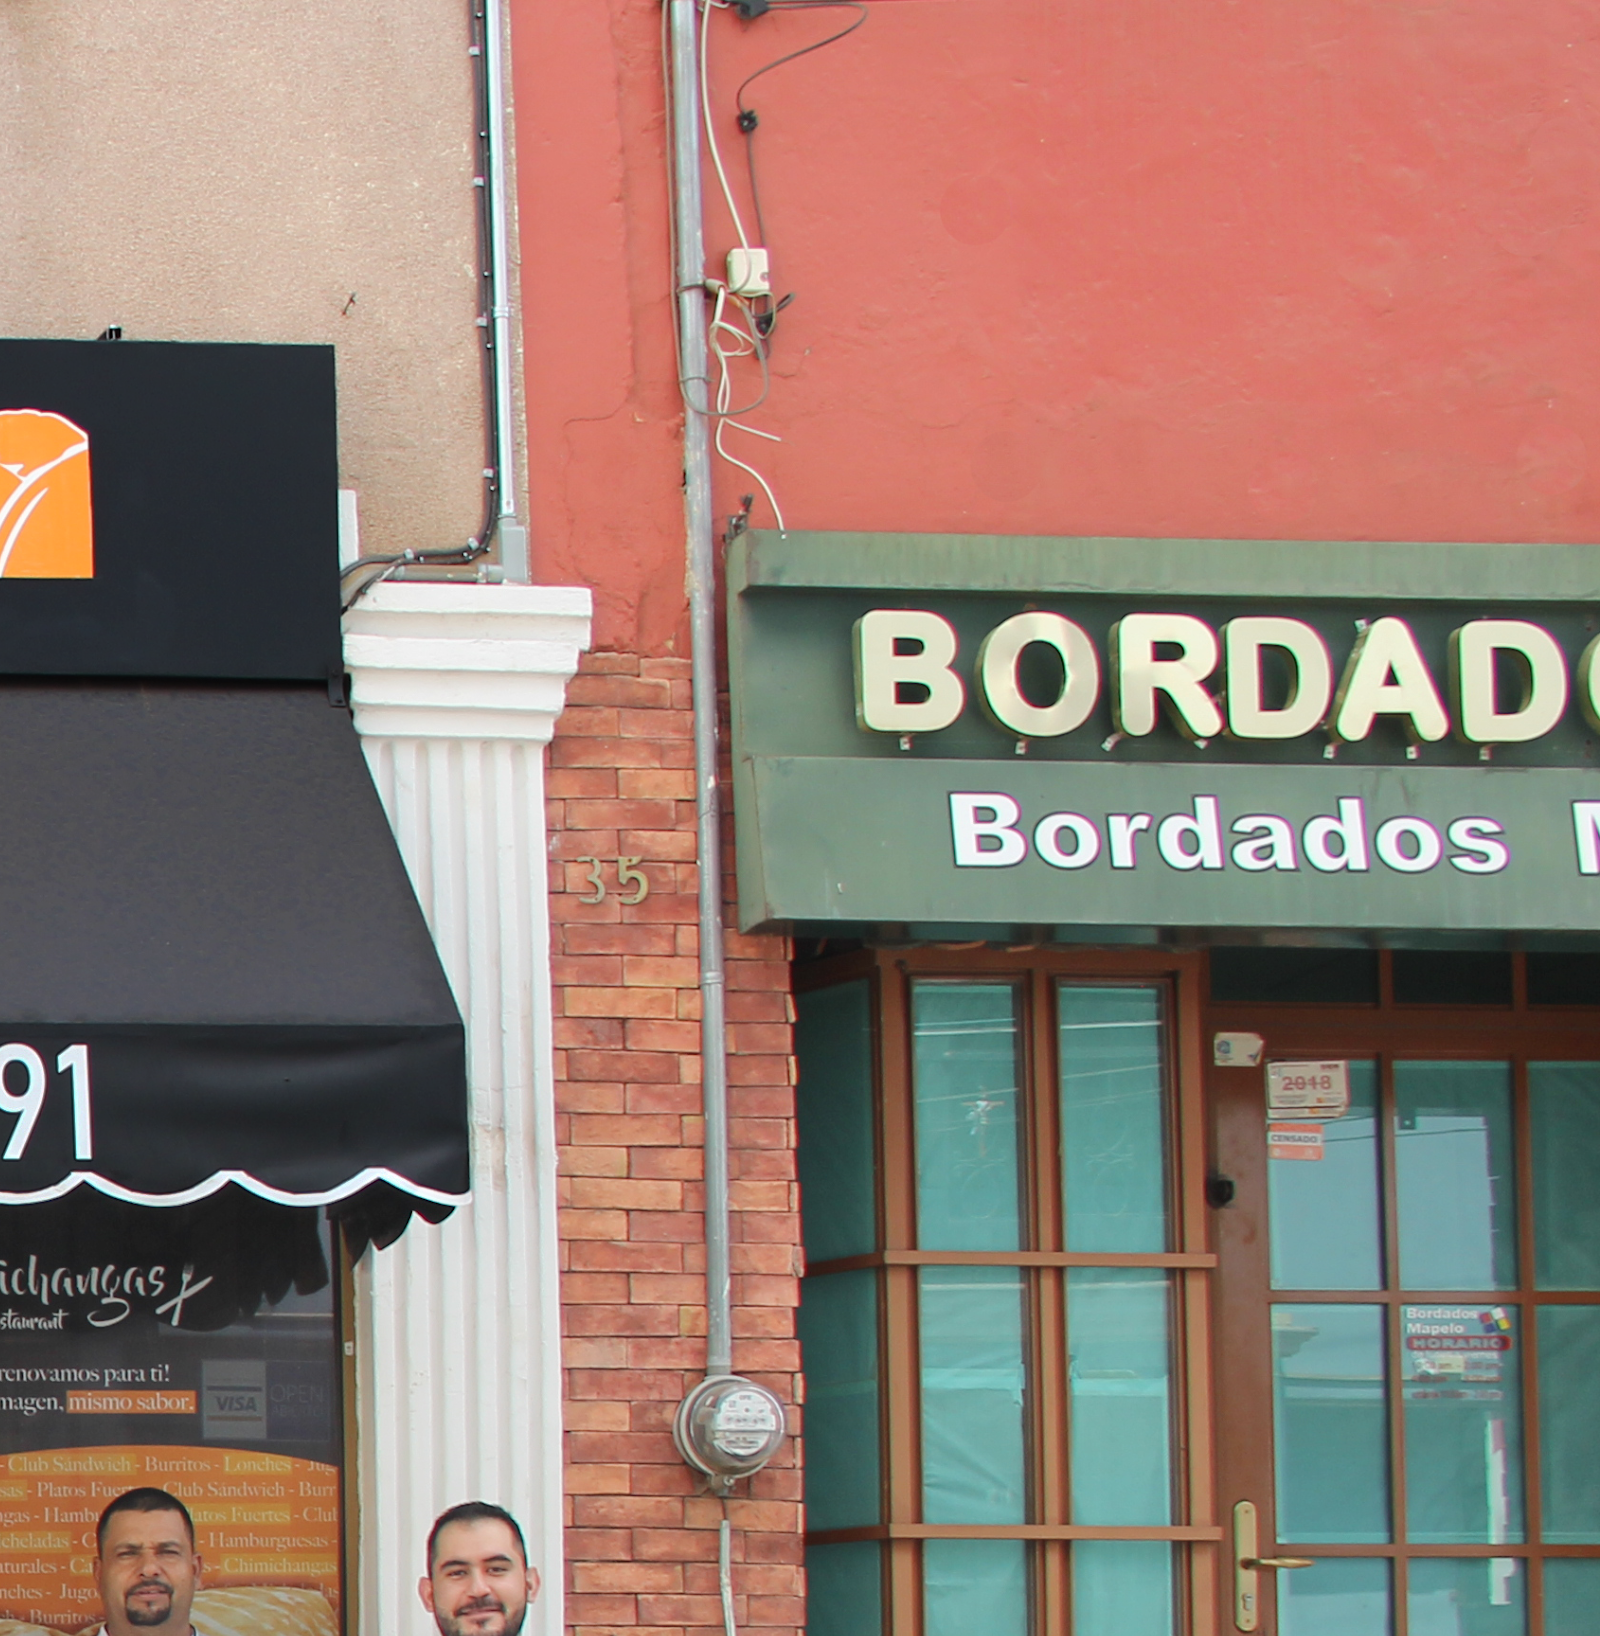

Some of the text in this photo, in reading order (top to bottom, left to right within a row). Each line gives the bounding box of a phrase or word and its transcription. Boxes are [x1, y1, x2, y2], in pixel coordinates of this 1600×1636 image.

[852, 608, 1600, 743] BORDAD
[948, 791, 1511, 874] Bordados
[576, 855, 649, 905] 35
[1282, 1075, 1332, 1091] 2018
[1271, 1134, 1318, 1143] CENSADO
[1406, 1307, 1479, 1319] Bordados
[1406, 1323, 1465, 1335] Mapelo
[104, 1367, 146, 1387] para
[150, 1364, 170, 1382] ti!
[68, 1392, 133, 1411] mismo
[137, 1391, 195, 1411] sabor.
[215, 1396, 257, 1412] VISA
[8, 1455, 49, 1473] Club
[52, 1455, 131, 1473] Sándwich
[145, 1456, 211, 1473] Burritos
[224, 1457, 292, 1473] Lonches
[36, 1481, 86, 1498] Platos
[207, 1481, 285, 1498] Sándwich
[232, 1508, 291, 1523] Fuertes
[209, 1532, 329, 1551] Hamburguesas
[224, 1558, 337, 1577] Chimichangas
[29, 1608, 94, 1625] Burritos
